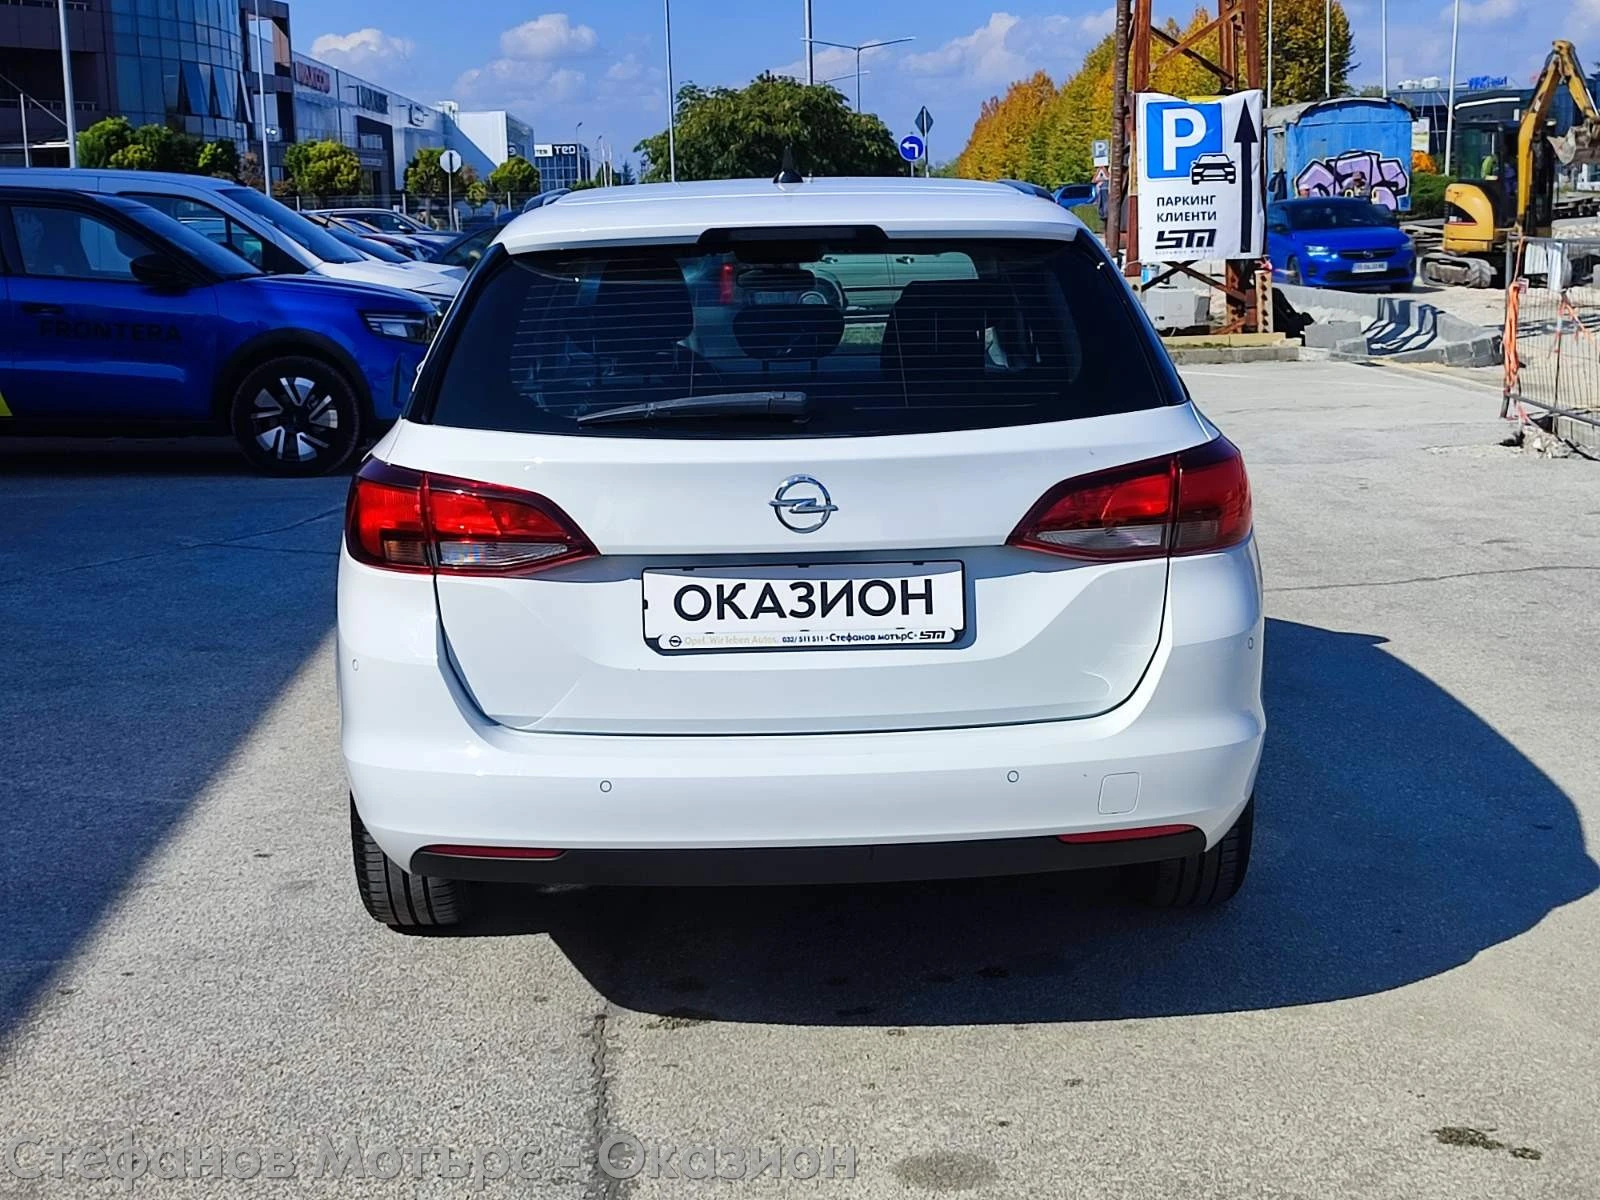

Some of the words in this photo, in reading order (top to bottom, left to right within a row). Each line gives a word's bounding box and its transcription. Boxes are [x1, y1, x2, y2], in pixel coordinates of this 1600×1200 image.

[1163, 108, 1206, 170] P
[1157, 195, 1216, 206] ПАРКИНГ
[1157, 211, 1217, 222] КЛИЕНТИ
[38, 320, 182, 343] FRONTERA
[673, 579, 934, 621] ОКАЗИОН
[829, 632, 876, 643] Стефанов
